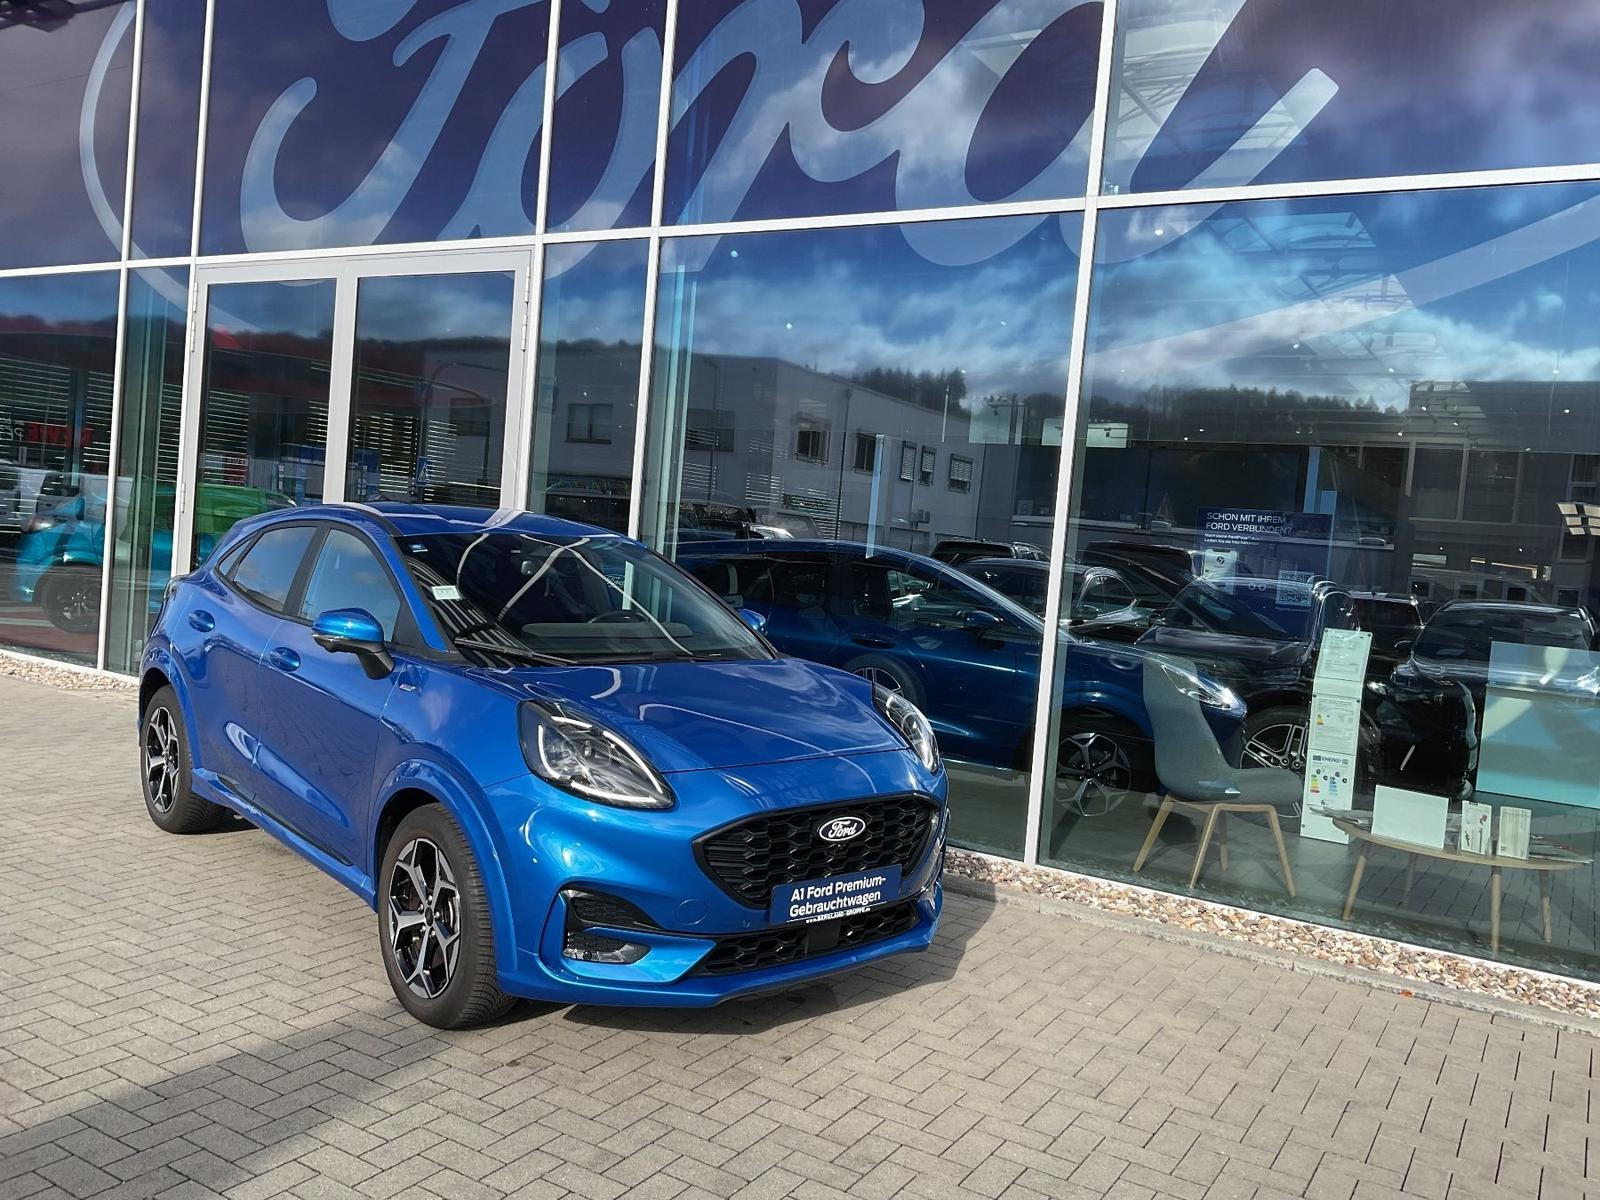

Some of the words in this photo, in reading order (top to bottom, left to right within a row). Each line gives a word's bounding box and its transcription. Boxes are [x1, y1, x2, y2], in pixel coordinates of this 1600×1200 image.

[240, 0, 1339, 268] Ford
[1206, 521, 1230, 531] FORD
[1231, 523, 1292, 534] VERBUNDEN?
[1207, 511, 1238, 521] SCHON
[1240, 513, 1256, 522] MIT
[1258, 515, 1286, 524] IHREM
[828, 820, 858, 838] Ford
[790, 887, 804, 902] A1
[807, 882, 833, 899] Ford
[835, 875, 886, 894] Premium-
[789, 891, 881, 917] Gebrauchtwagen
